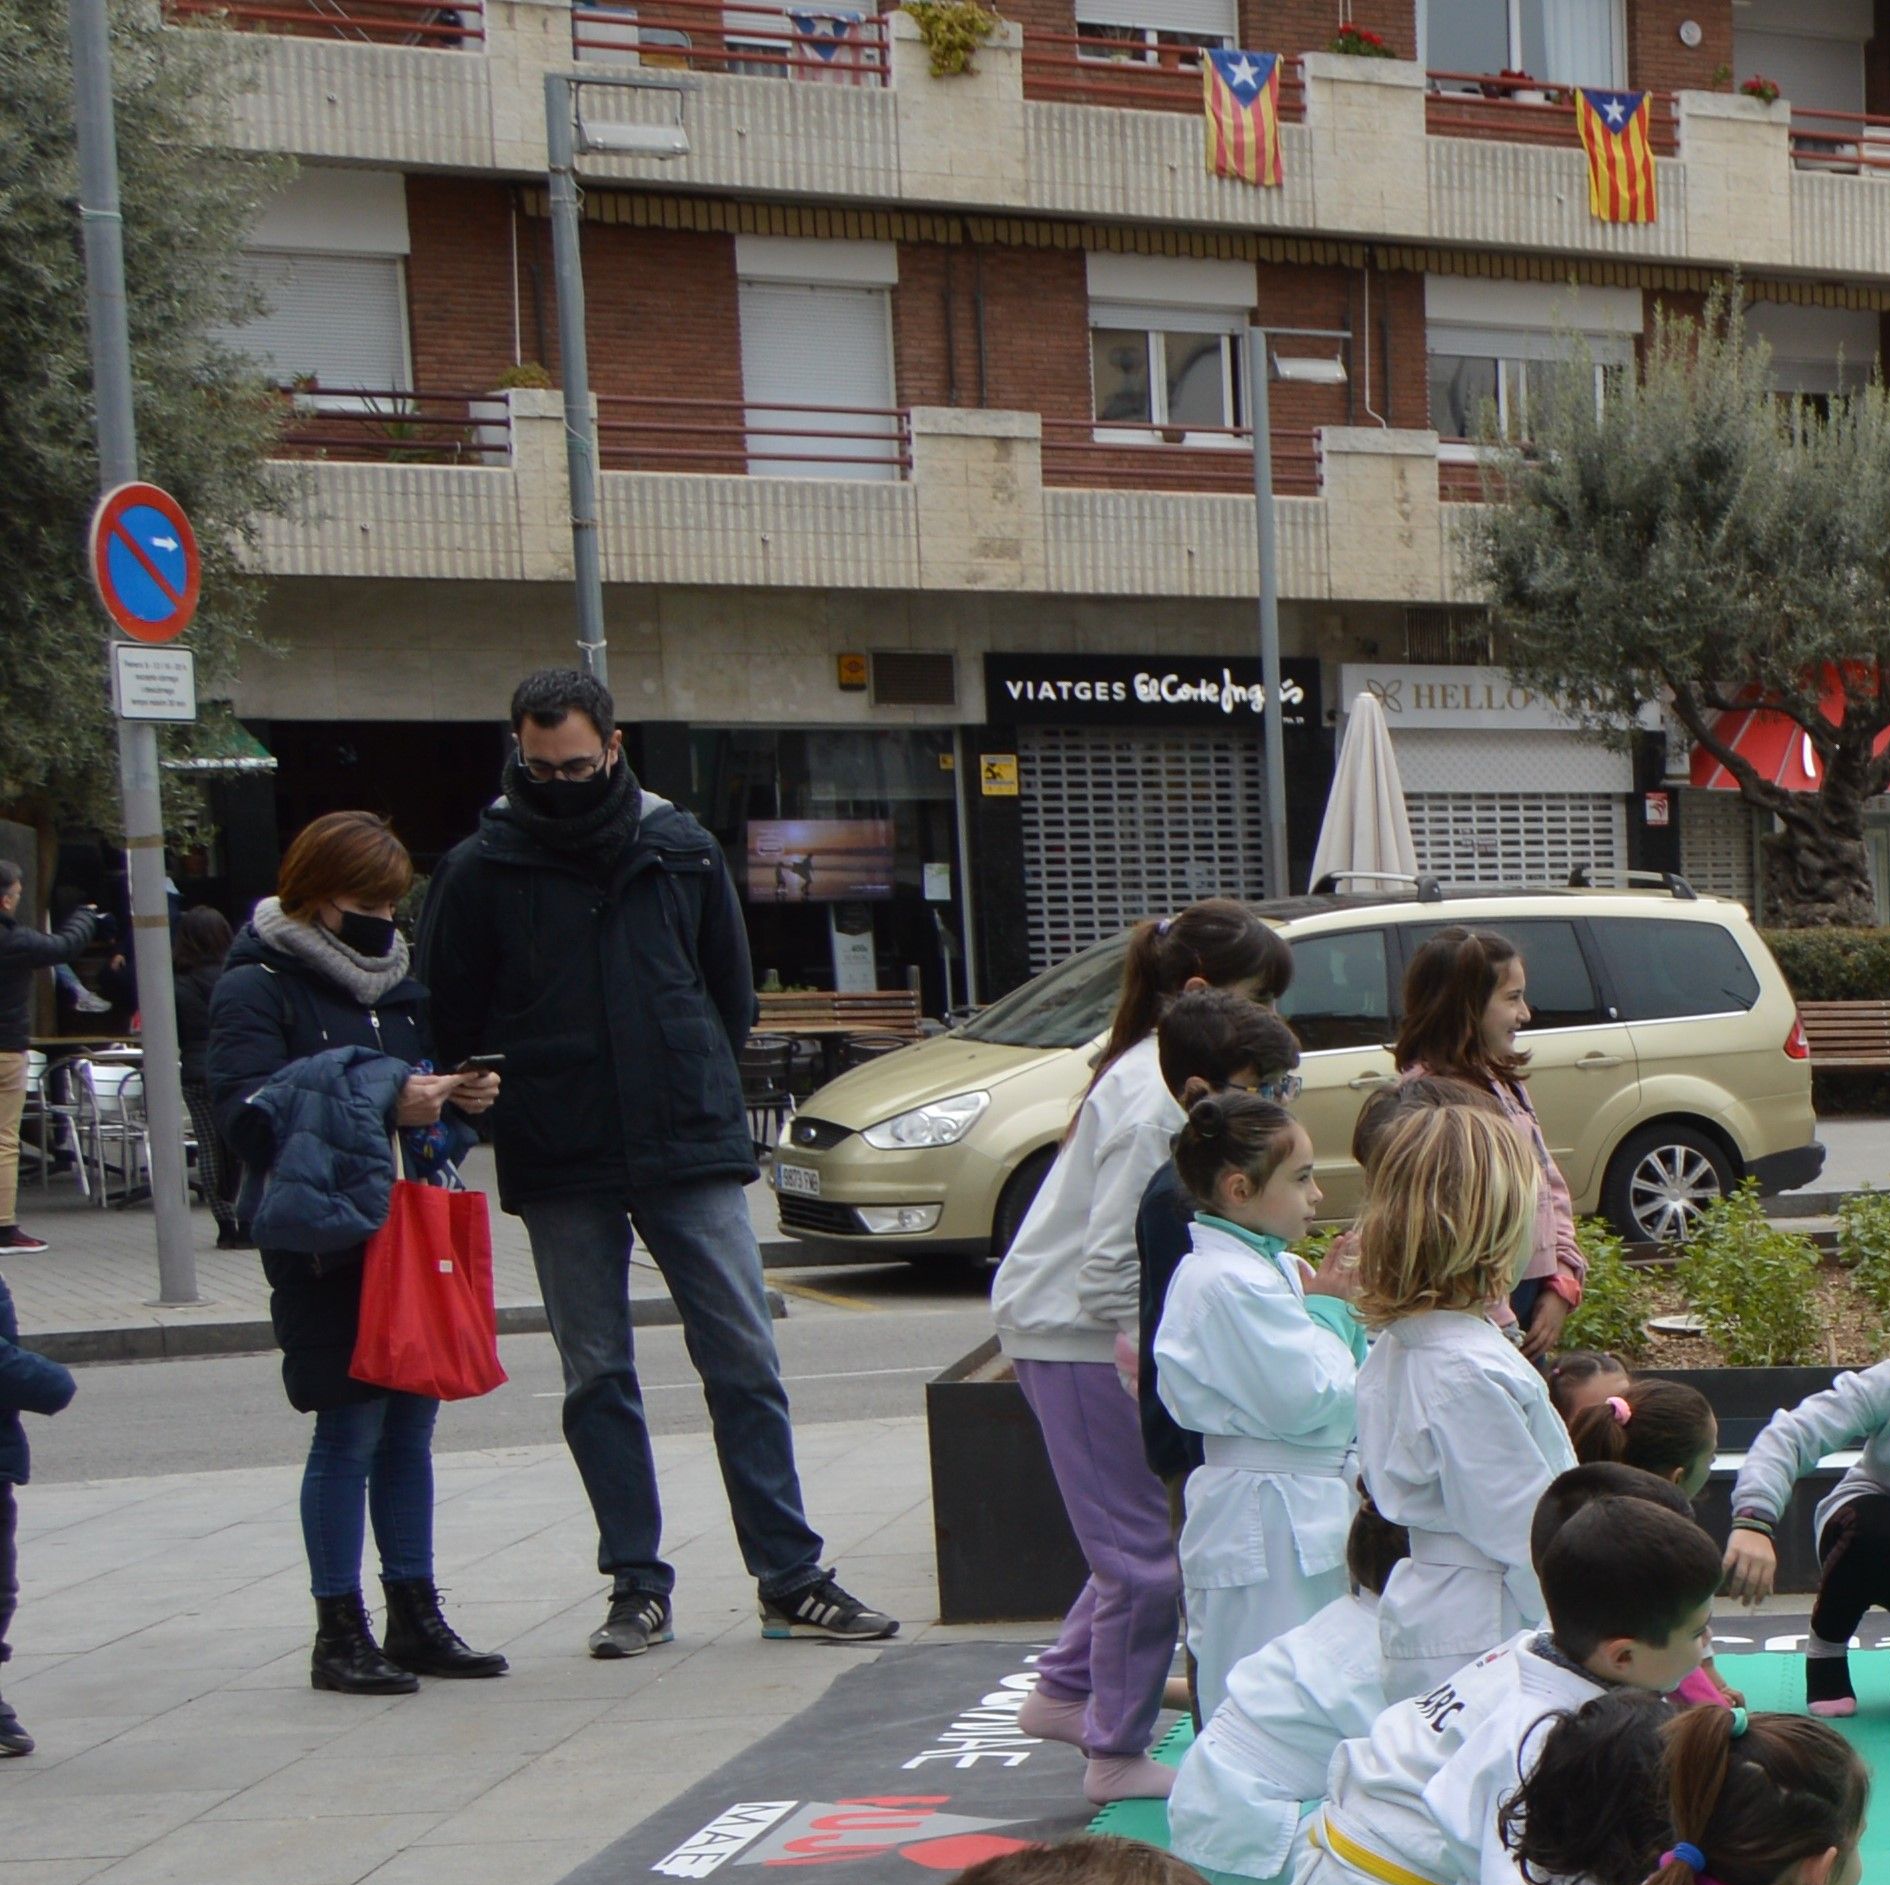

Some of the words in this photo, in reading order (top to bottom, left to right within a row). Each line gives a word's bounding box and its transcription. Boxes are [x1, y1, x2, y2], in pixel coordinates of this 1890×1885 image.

[1006, 681, 1126, 701] VIATGES
[1134, 672, 1161, 702] El
[1160, 674, 1219, 703] Corte
[1218, 667, 1304, 714] Ingés
[1413, 683, 1532, 712] HELLO
[1415, 1684, 1466, 1733] ARC
[666, 1803, 784, 1869] MAE
